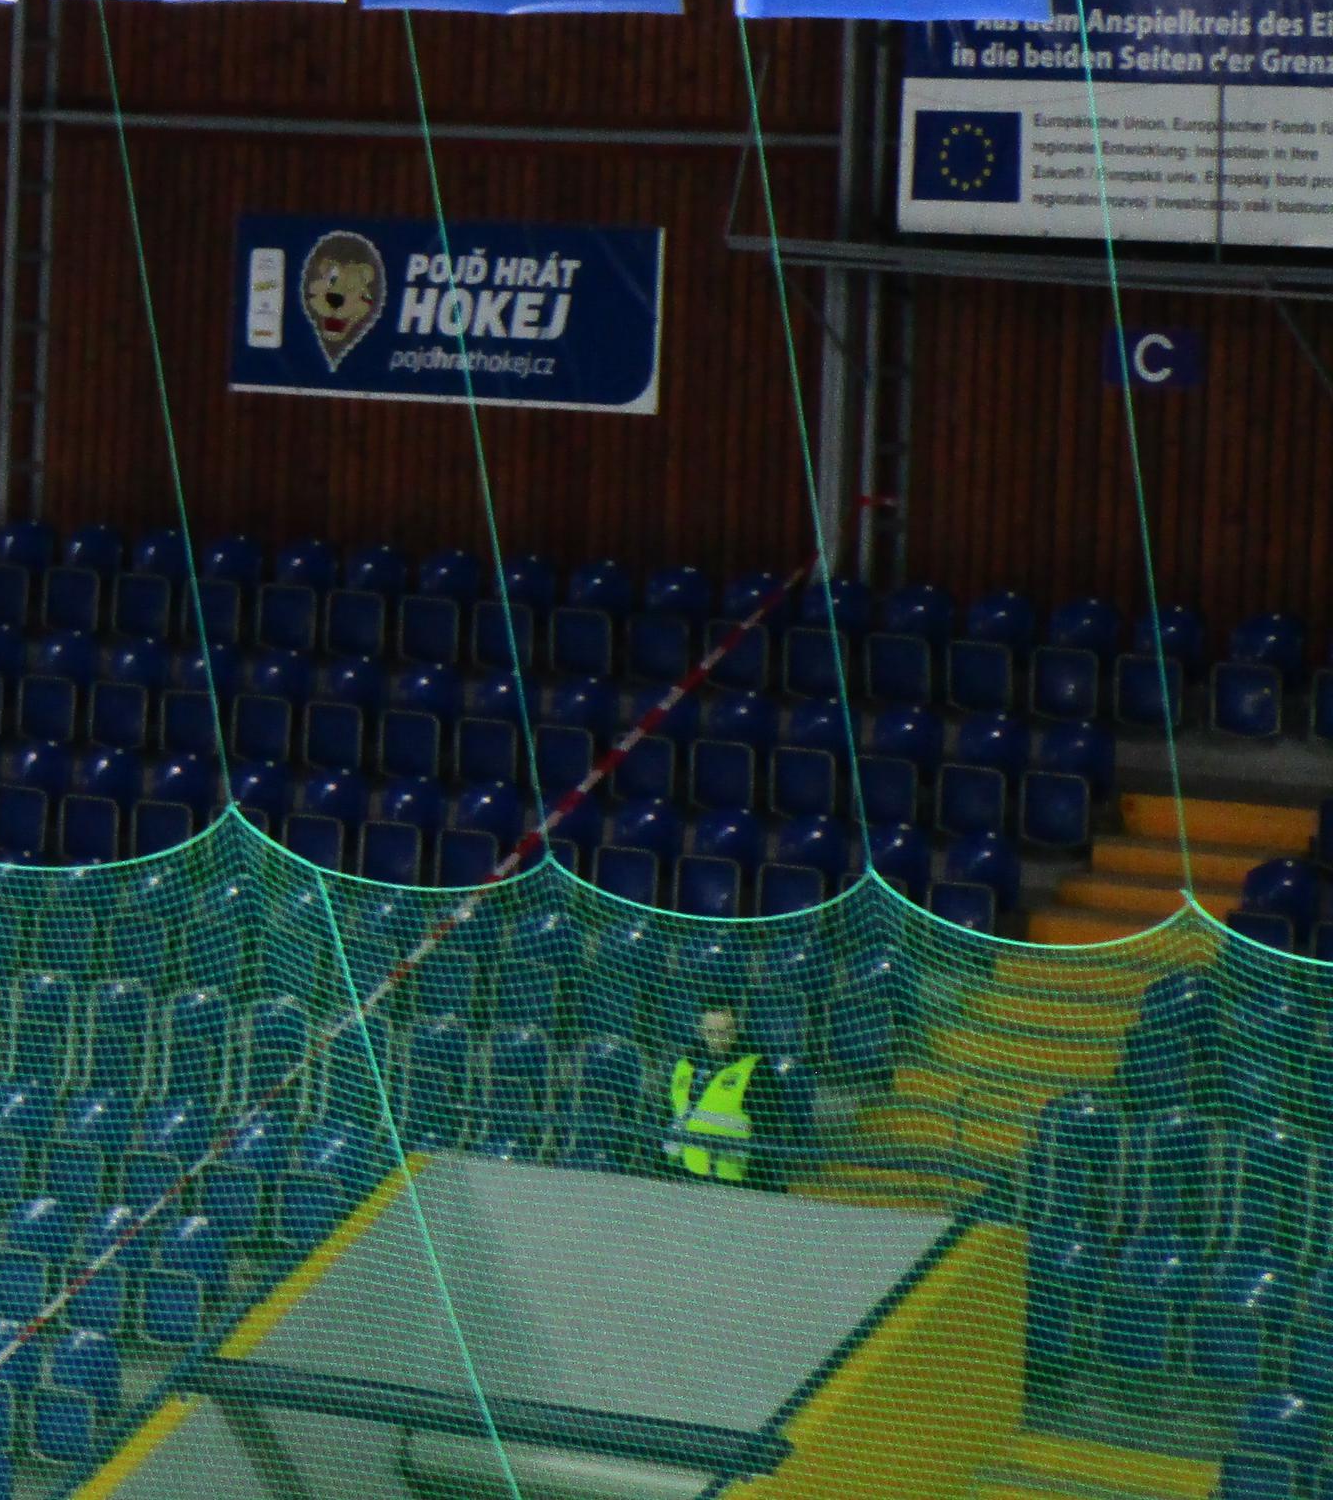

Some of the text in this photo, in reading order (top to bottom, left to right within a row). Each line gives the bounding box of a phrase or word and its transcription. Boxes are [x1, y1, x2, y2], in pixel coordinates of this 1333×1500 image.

[1086, 8, 1252, 40] Anspielkreis
[1257, 11, 1304, 37] des
[952, 41, 976, 67] in
[981, 42, 1019, 68] die
[1024, 41, 1113, 70] beiden
[1119, 46, 1203, 71] Seiten
[406, 248, 582, 288] POJĎ HRÁT
[397, 287, 572, 340] HOKEJ
[1134, 333, 1175, 383] C
